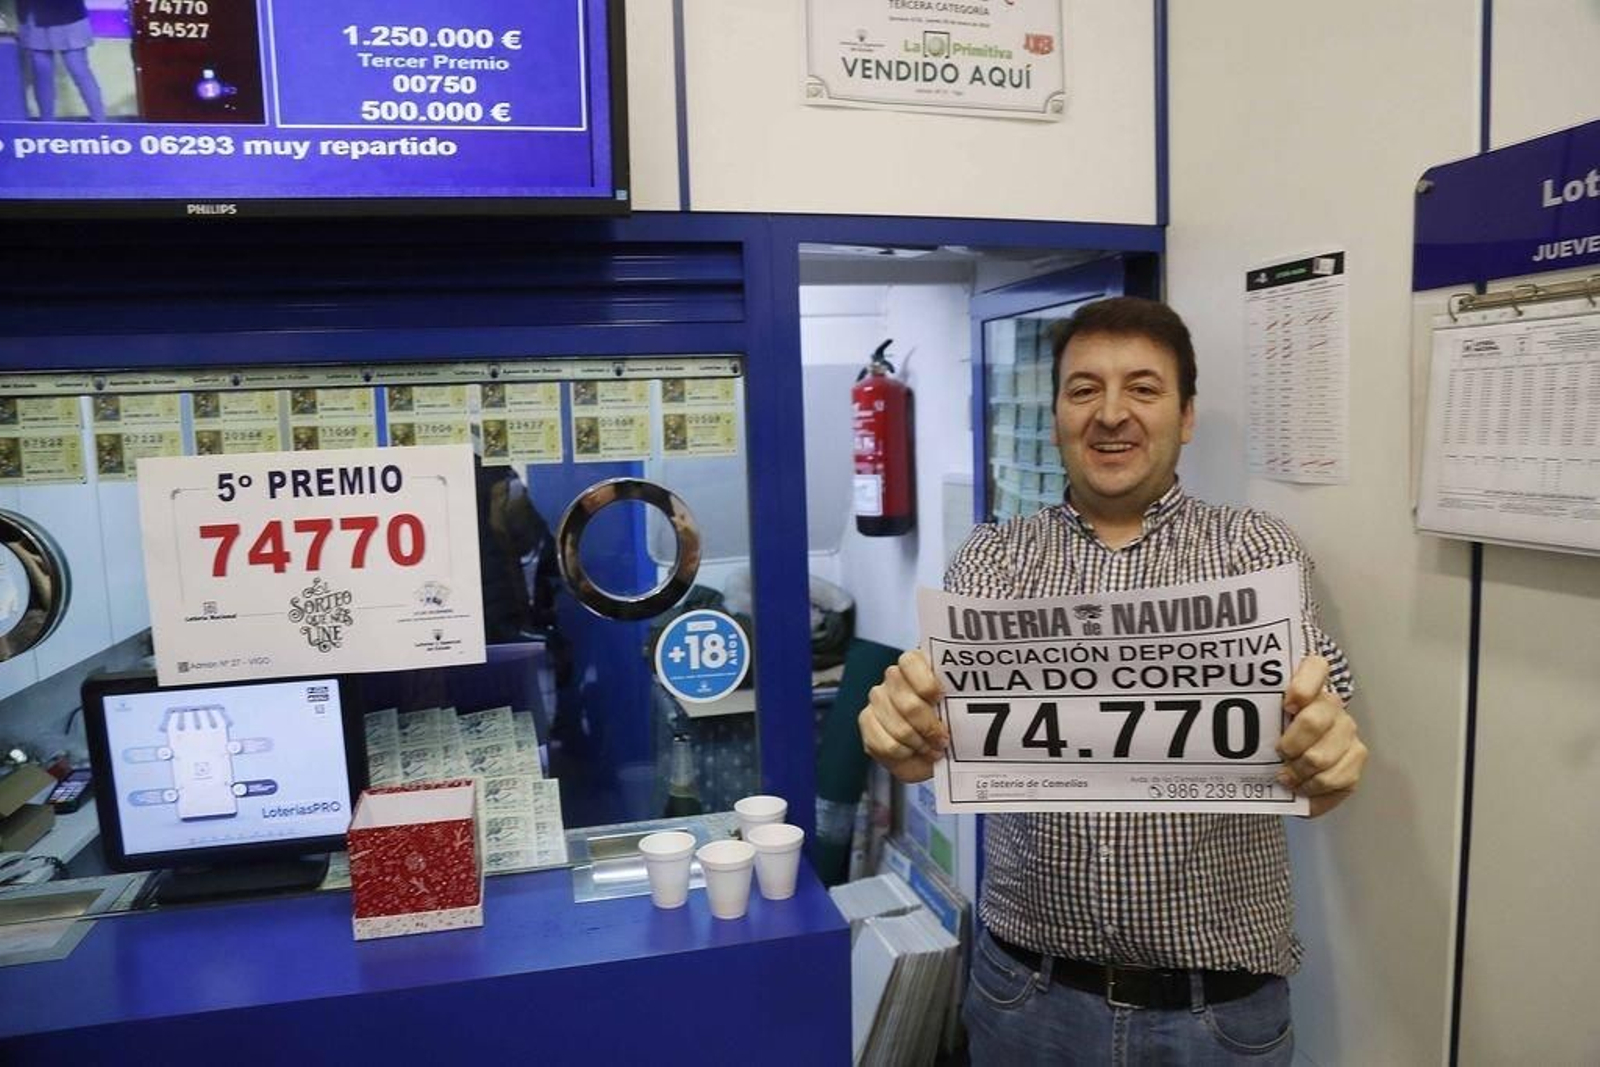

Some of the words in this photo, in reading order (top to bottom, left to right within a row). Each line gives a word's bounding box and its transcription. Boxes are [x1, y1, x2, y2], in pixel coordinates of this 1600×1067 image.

[146, 0, 209, 15] 74770
[149, 21, 209, 38] 54527
[342, 25, 494, 48] 1.250.000
[501, 30, 522, 50] €
[357, 52, 428, 69] Tercer
[433, 54, 510, 70] Premio
[952, 42, 1013, 60] Primitiva
[393, 74, 477, 94] 00750
[841, 57, 960, 84] VENDIDO
[969, 63, 1032, 90] AQUÍ
[361, 101, 483, 121] 500.000
[490, 102, 512, 122] €
[14, 134, 132, 158] premio
[139, 135, 235, 155] 06293
[243, 139, 311, 159] muy
[319, 137, 458, 159] repartido
[186, 203, 237, 215] PHILIPS
[217, 473, 252, 502] 5º
[268, 464, 403, 499] PREMIO
[199, 513, 426, 578] 74770
[287, 590, 352, 623] SORTEO
[948, 606, 1072, 641] LOTERIA
[1082, 620, 1101, 636] de
[1111, 587, 1258, 636] NAVIDAD
[667, 633, 728, 670] +18
[940, 642, 1109, 666] ASOCIACIÓN
[1119, 632, 1282, 662] DEPORTIVA
[945, 669, 1033, 692] VILA
[1042, 667, 1098, 690] DO
[1112, 659, 1284, 689] CORPUS
[966, 698, 1261, 760] 74.770
[1026, 779, 1040, 788] de
[1167, 783, 1199, 799] 986
[1205, 783, 1237, 799] 239
[1243, 783, 1274, 799] 091
